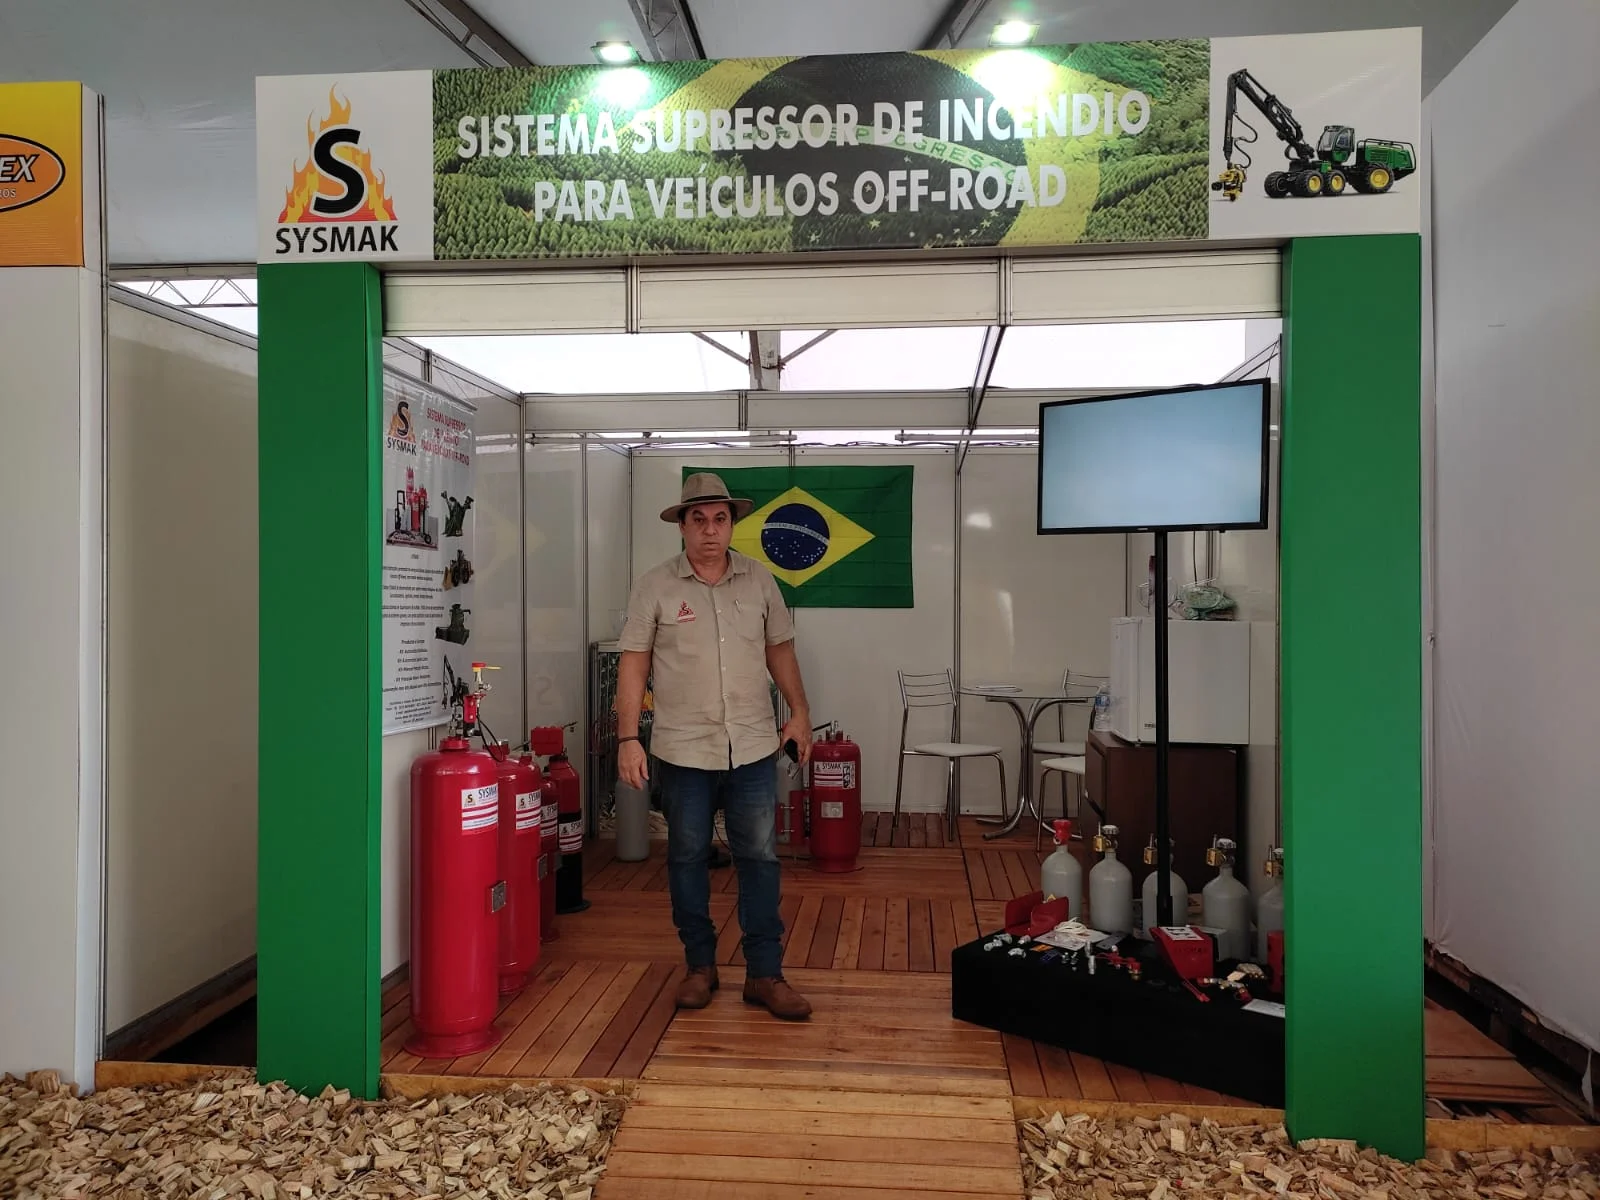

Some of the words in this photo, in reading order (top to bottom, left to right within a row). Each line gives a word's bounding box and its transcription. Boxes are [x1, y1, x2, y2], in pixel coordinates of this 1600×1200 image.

[457, 111, 620, 159] SISTEMA
[632, 104, 859, 154] SUPRESSOR
[873, 100, 924, 145] DE
[313, 128, 365, 214] S
[534, 179, 635, 222] PARA
[645, 163, 840, 219] VEÍCULOS
[853, 163, 1067, 214] OFF-ROAD
[275, 225, 399, 254] SYSMAK
[387, 437, 417, 456] SYSMAK
